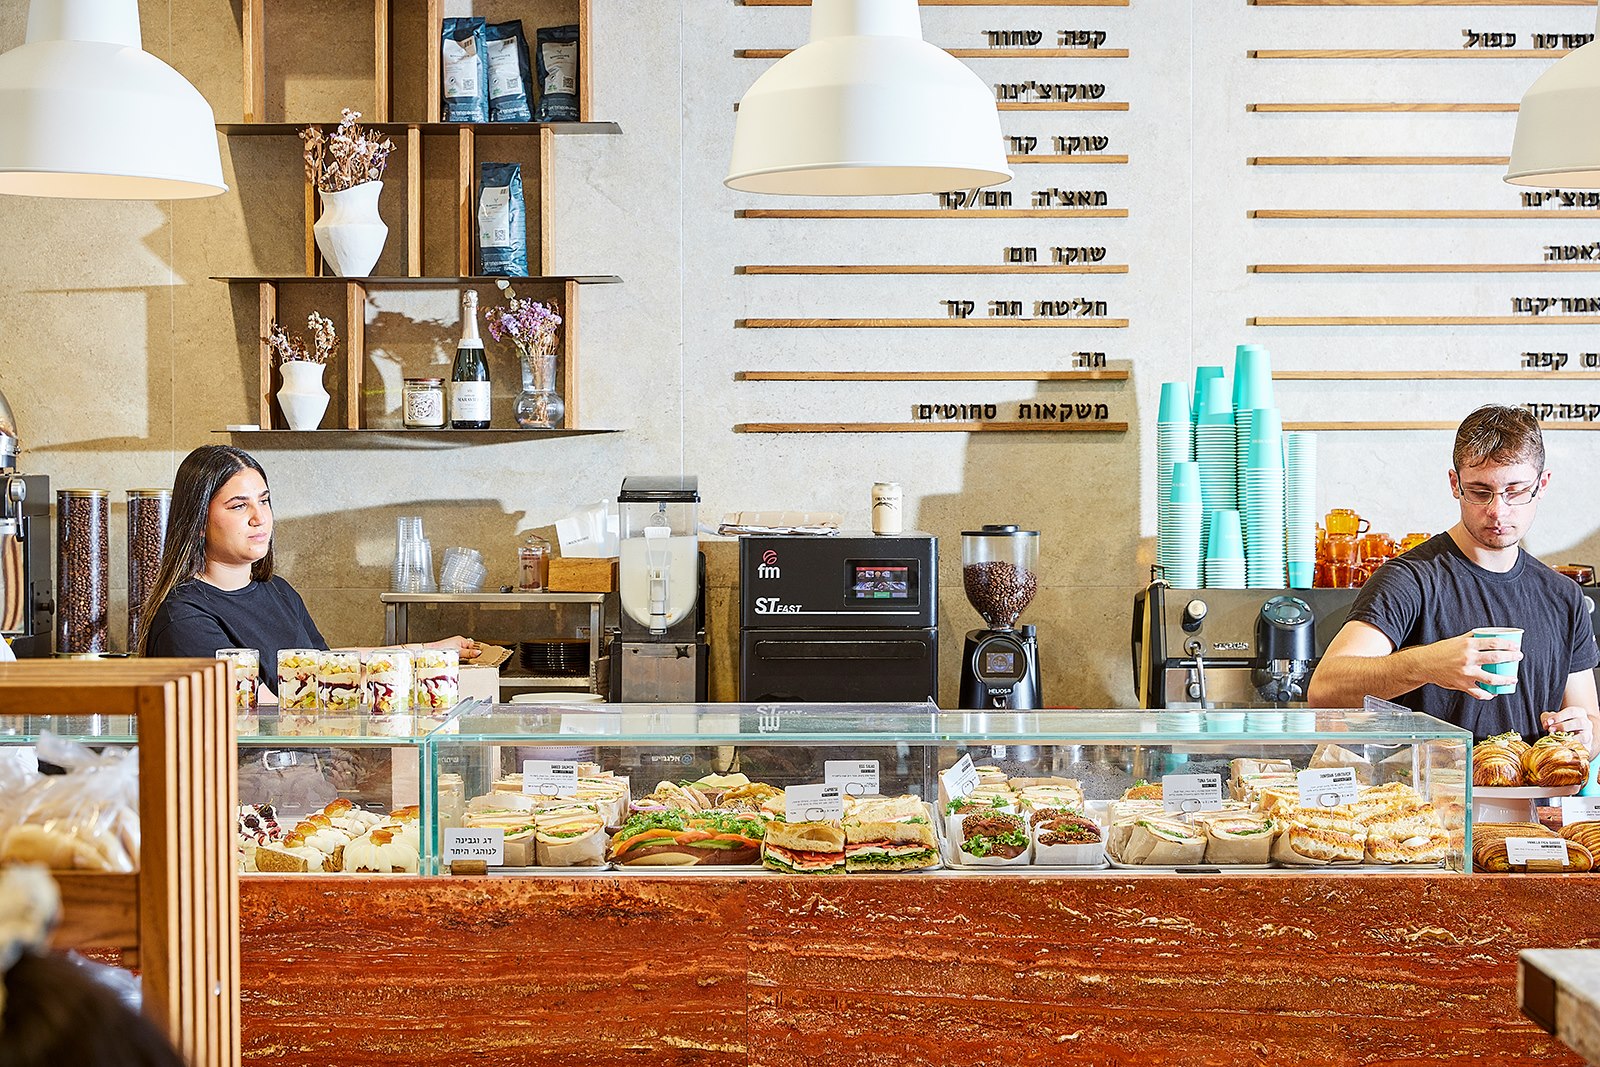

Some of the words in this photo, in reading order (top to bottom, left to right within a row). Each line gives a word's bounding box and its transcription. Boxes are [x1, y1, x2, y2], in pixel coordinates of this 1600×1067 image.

[986, 30, 1042, 46] שחור
[1064, 30, 1106, 49] קפה
[1466, 29, 1516, 48] כפול
[1537, 33, 1595, 49] פרסו
[1000, 81, 1106, 102] שוקוצ'ינו
[1010, 136, 1037, 154] קר
[1058, 136, 1108, 155] שוקו
[1038, 188, 1107, 206] מאצ'ה
[1525, 189, 1600, 207] פוצ'ינו
[1010, 246, 1037, 262] חם
[1056, 246, 1106, 265] שוקו
[946, 299, 975, 318] קר
[995, 300, 1023, 316] תה
[1040, 297, 1107, 316] חליטת
[1515, 297, 1600, 316] אמריקנו
[1078, 351, 1106, 368] תה
[1526, 352, 1568, 371] קפה
[919, 403, 997, 420] סחוטים
[1018, 403, 1109, 422] משקאות
[757, 563, 781, 579] fm
[472, 847, 497, 855] לנוהגי
